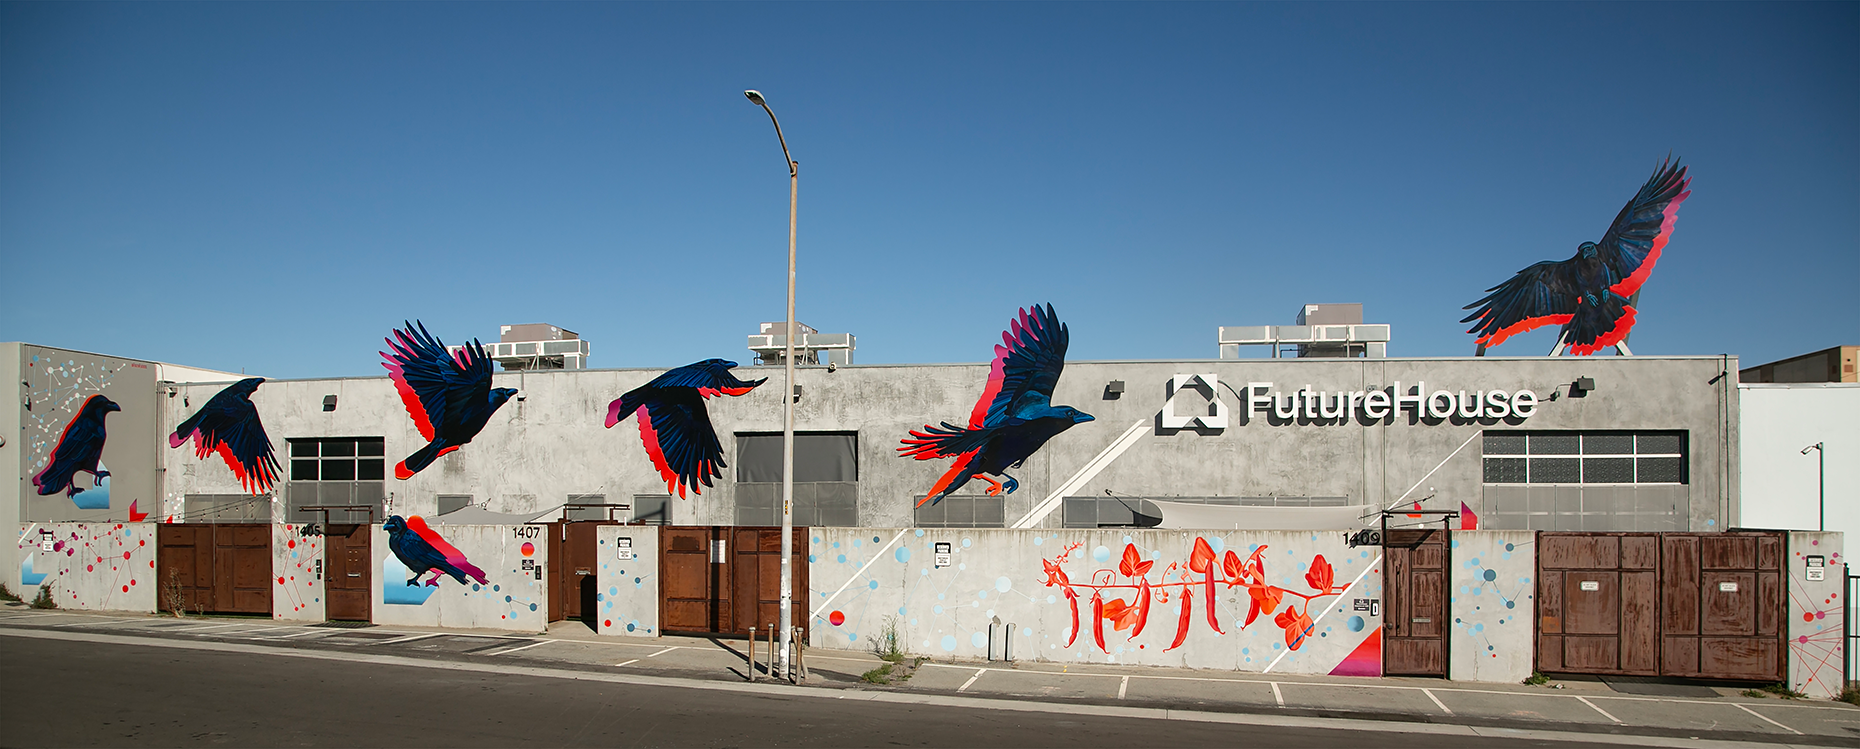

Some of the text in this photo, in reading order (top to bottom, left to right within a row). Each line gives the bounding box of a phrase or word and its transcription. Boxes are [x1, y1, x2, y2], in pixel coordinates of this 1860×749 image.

[1247, 380, 1538, 420] FutureHouse
[295, 525, 321, 537] 1405
[512, 526, 540, 539] 1407
[1343, 532, 1381, 546] 1409
